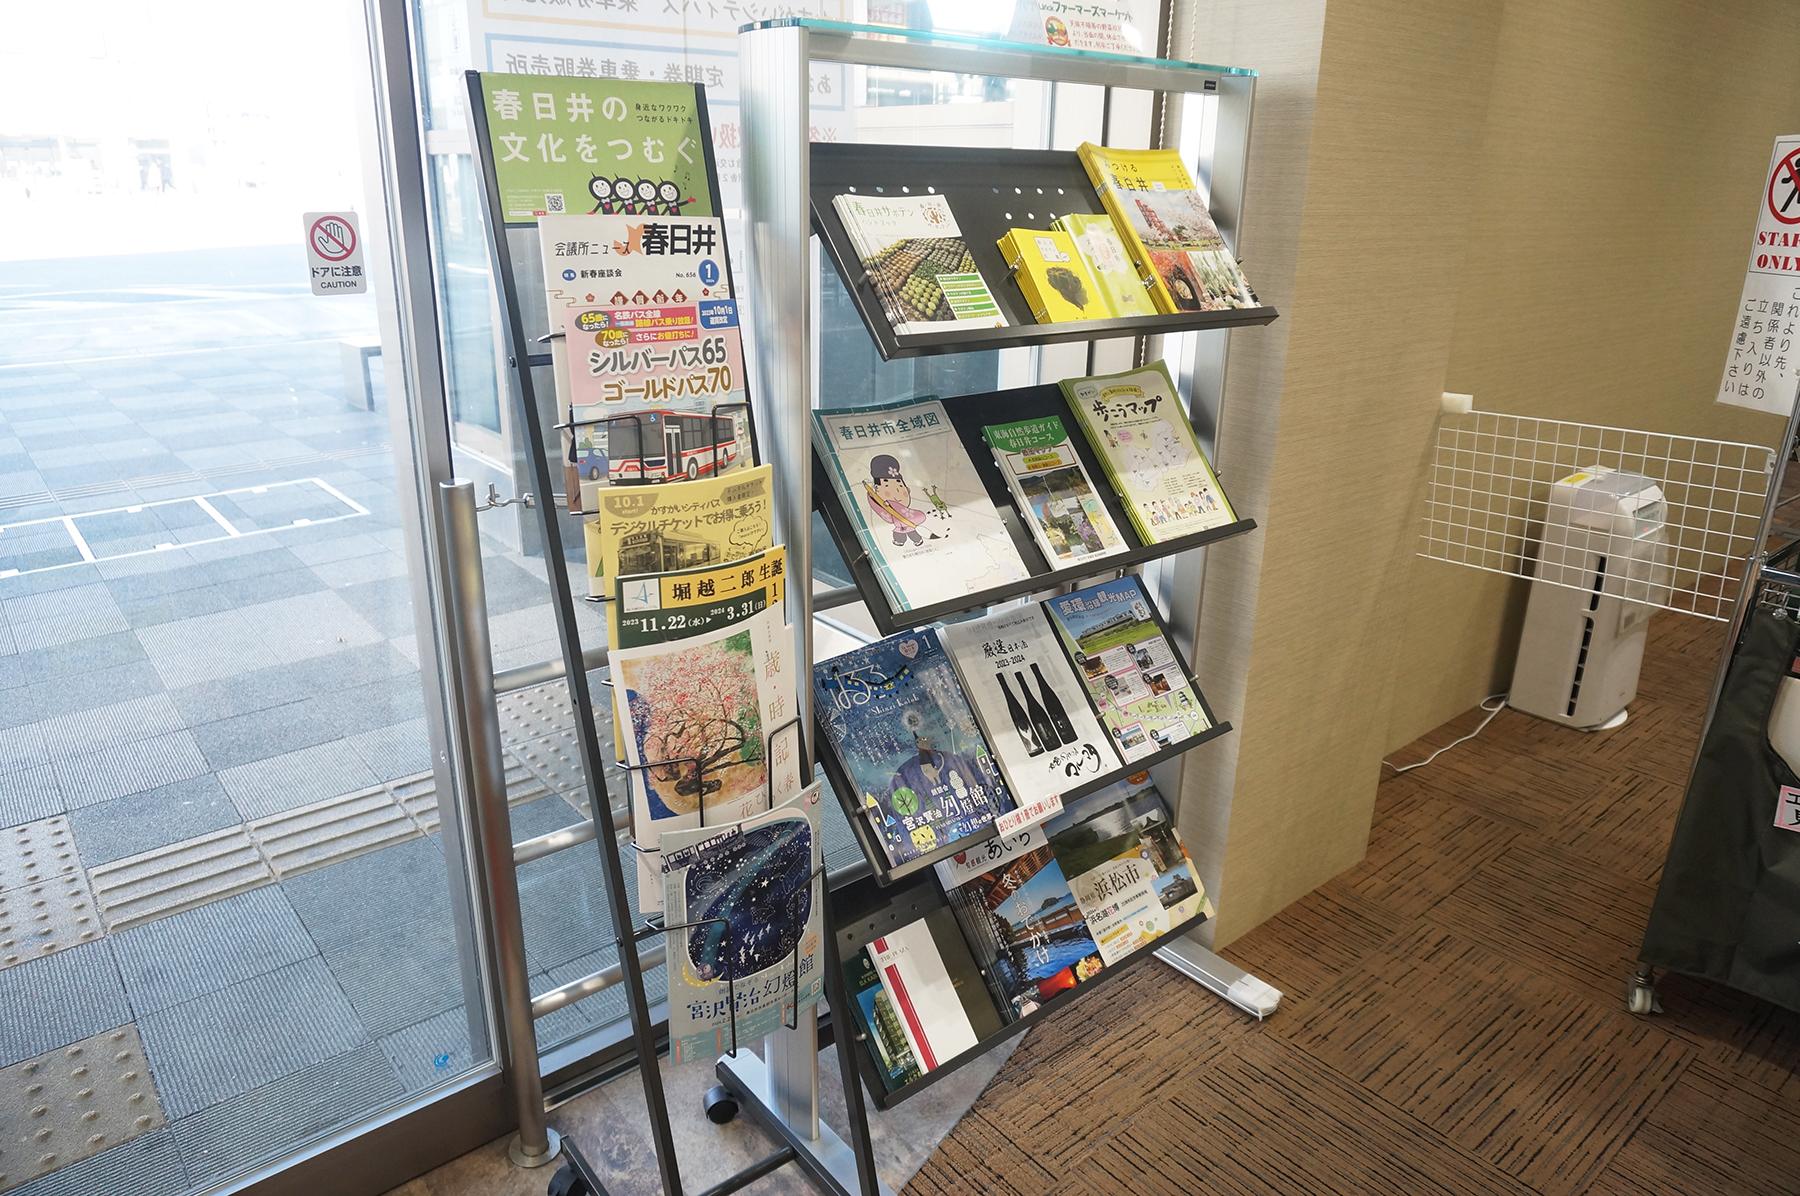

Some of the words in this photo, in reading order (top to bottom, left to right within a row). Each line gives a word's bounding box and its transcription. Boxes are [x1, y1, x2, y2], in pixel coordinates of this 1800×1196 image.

[492, 89, 628, 123] 春日井の
[635, 103, 686, 113] 身近なワクワク
[636, 115, 693, 124] つながるドキドキ
[499, 132, 697, 164] 文化をつむぐ
[1111, 174, 1149, 193] 春日井
[555, 240, 631, 257] 会議所ニュース
[642, 223, 717, 255] 春日井
[311, 266, 362, 278] ドアに注意
[705, 263, 712, 279] 1
[321, 281, 357, 289] CAUTION
[590, 337, 726, 374] シルバーパス65
[1725, 298, 1756, 393] ご遠慮下さい
[1737, 300, 1770, 396] 立ち入りは
[1752, 301, 1785, 400] 関係者以外の
[604, 365, 732, 401] ゴールドパス70
[1093, 395, 1163, 421] 歩こうマップ
[839, 411, 940, 441] 春日井市全域図
[993, 421, 1059, 440] 東海自然歩道ガイド
[1008, 433, 1054, 449] 春日井コース
[614, 495, 644, 508] 10.1
[651, 498, 722, 516] かすがいシティバス
[610, 499, 767, 537] デジタルチケットでお得に乗ろう!
[672, 557, 785, 600] 堀越二郎生誕
[622, 619, 639, 627] 2023
[995, 655, 1026, 669] 2023-2024
[985, 832, 1031, 860] あいり
[1094, 864, 1140, 901] 浜松市
[1002, 873, 1049, 964] 冬のおでかけ
